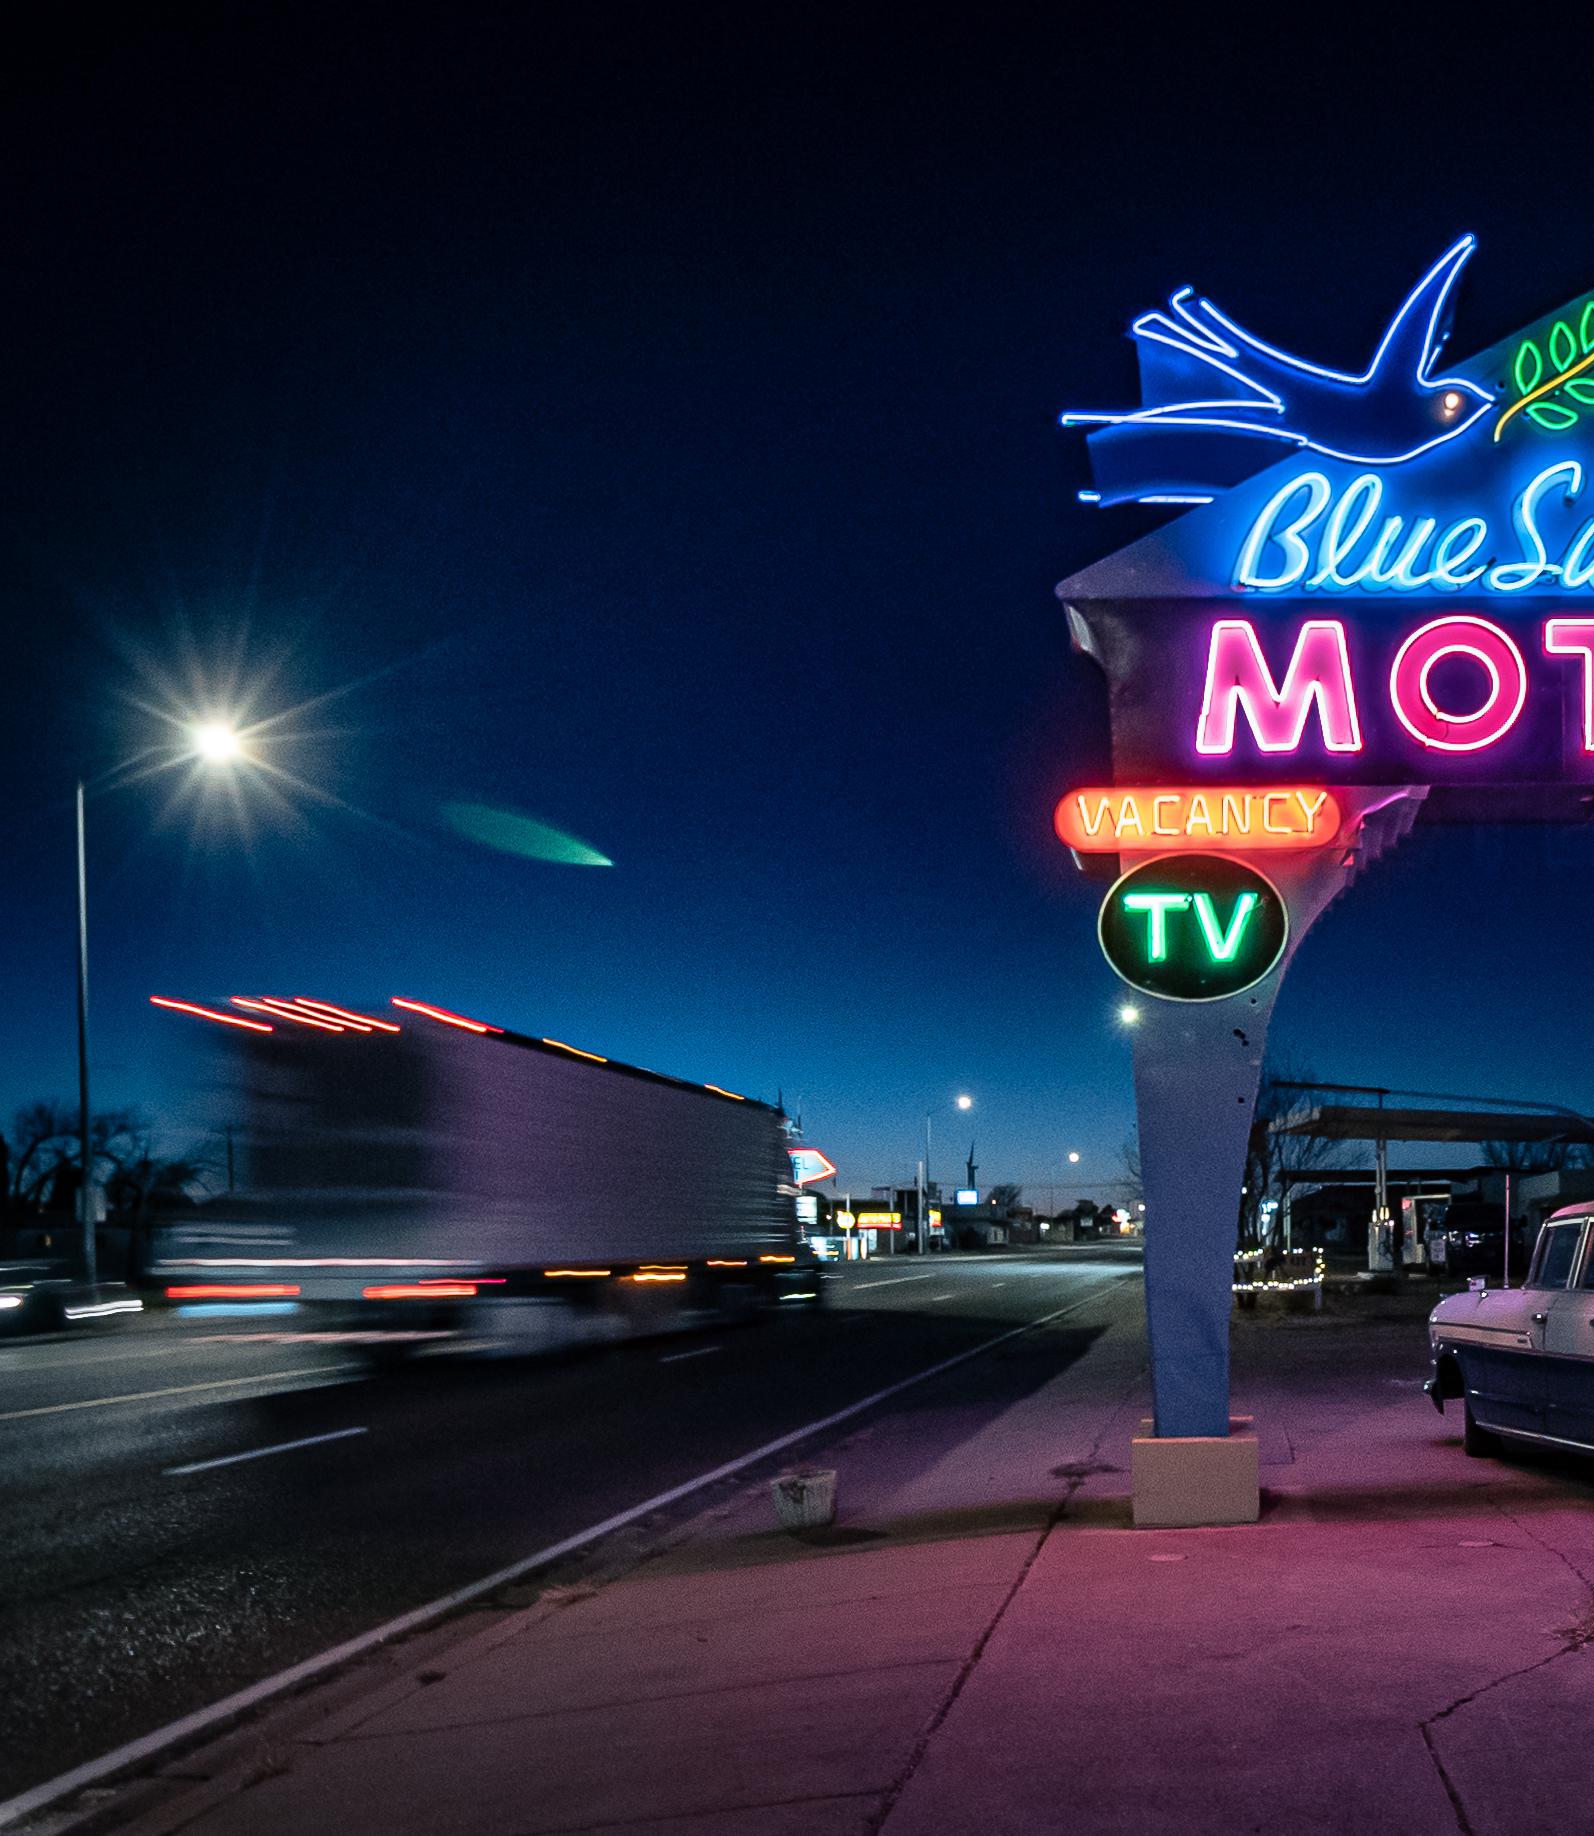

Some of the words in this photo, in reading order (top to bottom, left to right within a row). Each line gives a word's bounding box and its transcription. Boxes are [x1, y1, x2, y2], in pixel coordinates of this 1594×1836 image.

[1235, 470, 1491, 592] Blue
[1076, 790, 1329, 838] VACANCY
[1122, 891, 1259, 964] TV
